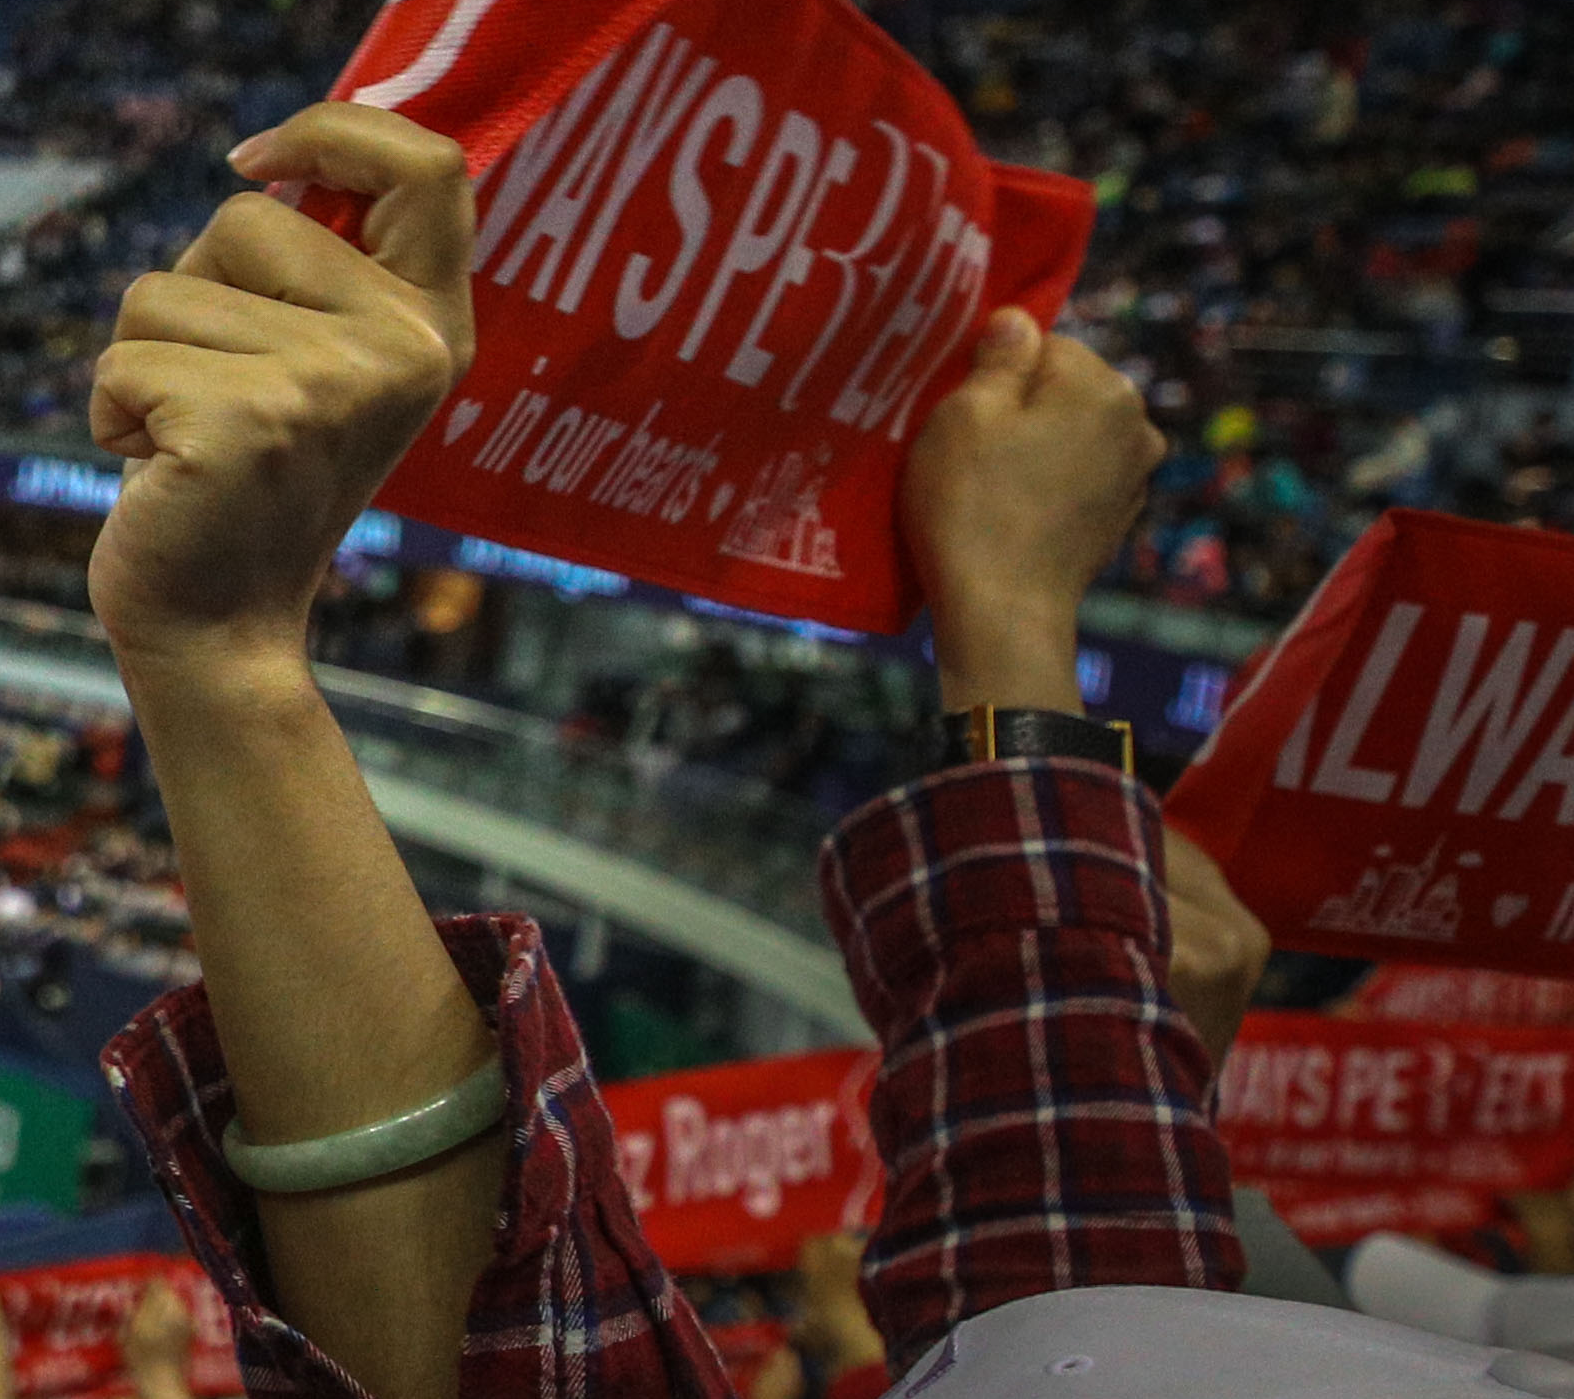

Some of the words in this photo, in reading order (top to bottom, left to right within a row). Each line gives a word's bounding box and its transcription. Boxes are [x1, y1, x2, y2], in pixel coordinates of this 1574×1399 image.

[473, 355, 550, 474] in
[523, 404, 629, 496] our
[590, 399, 725, 525] hearts
